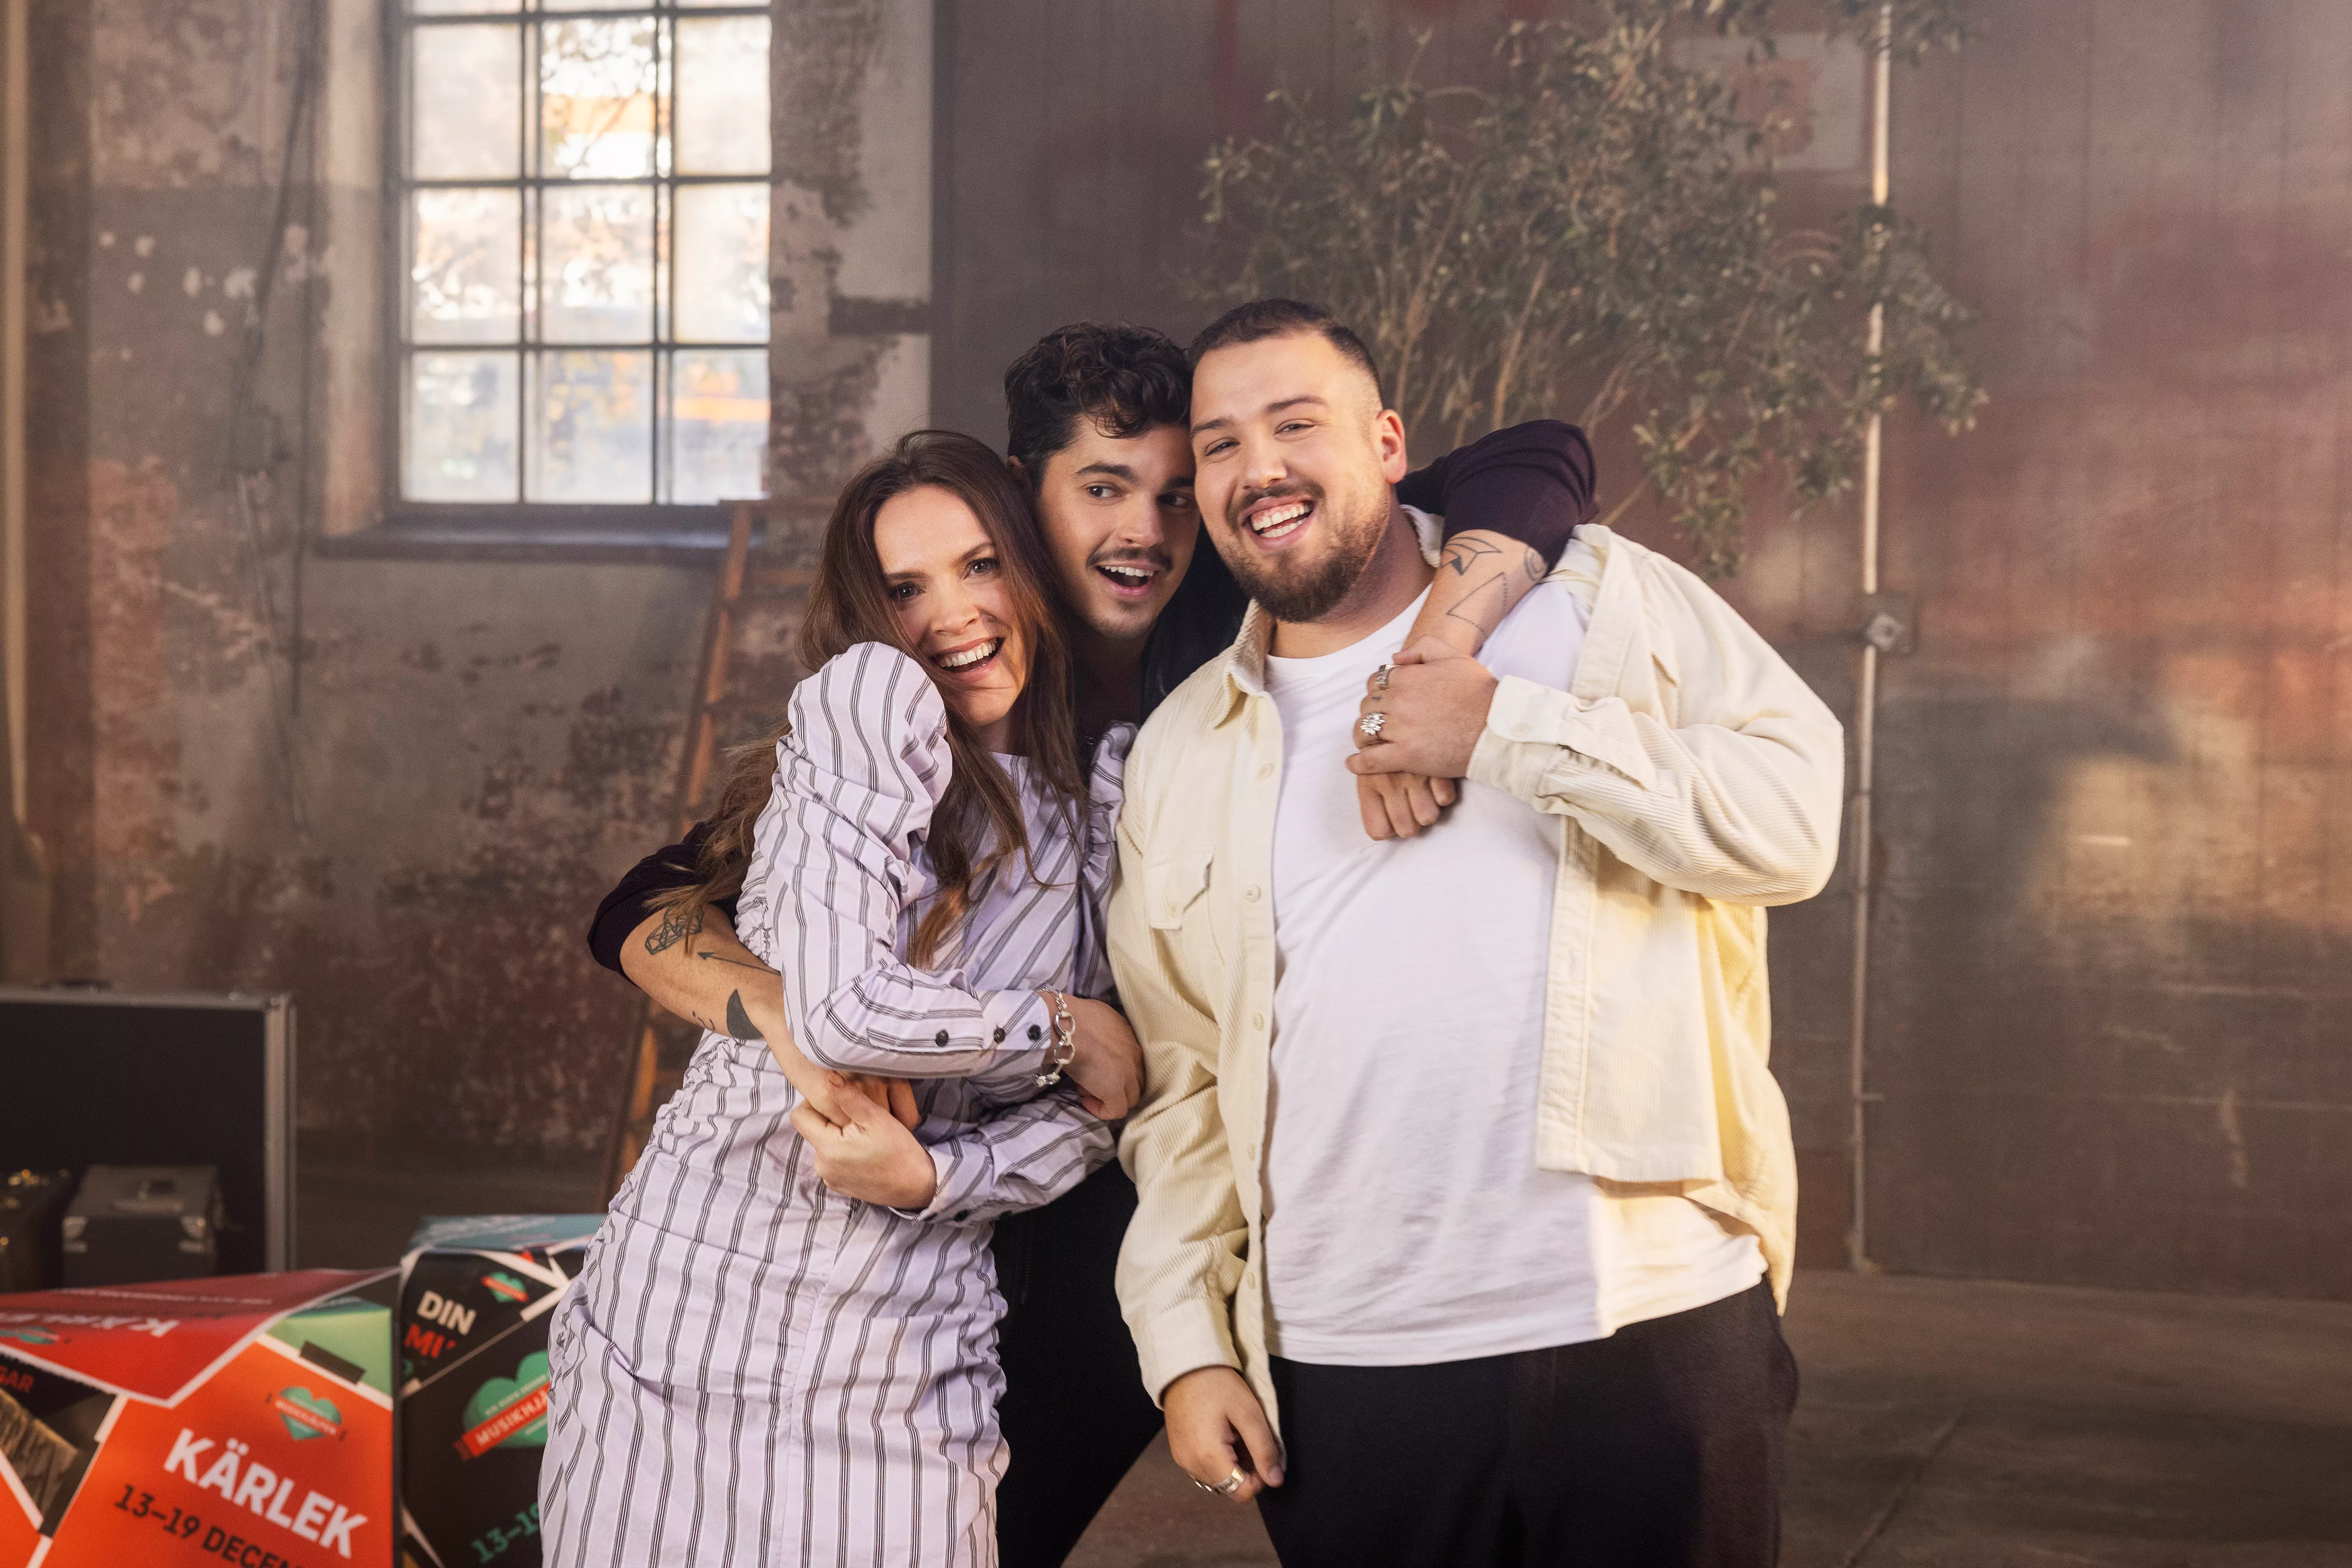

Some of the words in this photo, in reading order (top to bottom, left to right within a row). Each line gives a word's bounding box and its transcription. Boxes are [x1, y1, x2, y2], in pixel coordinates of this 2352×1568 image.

[417, 1290, 477, 1336] DIN
[163, 1427, 368, 1560] KÄRLEK
[202, 1525, 302, 1568] DECE
